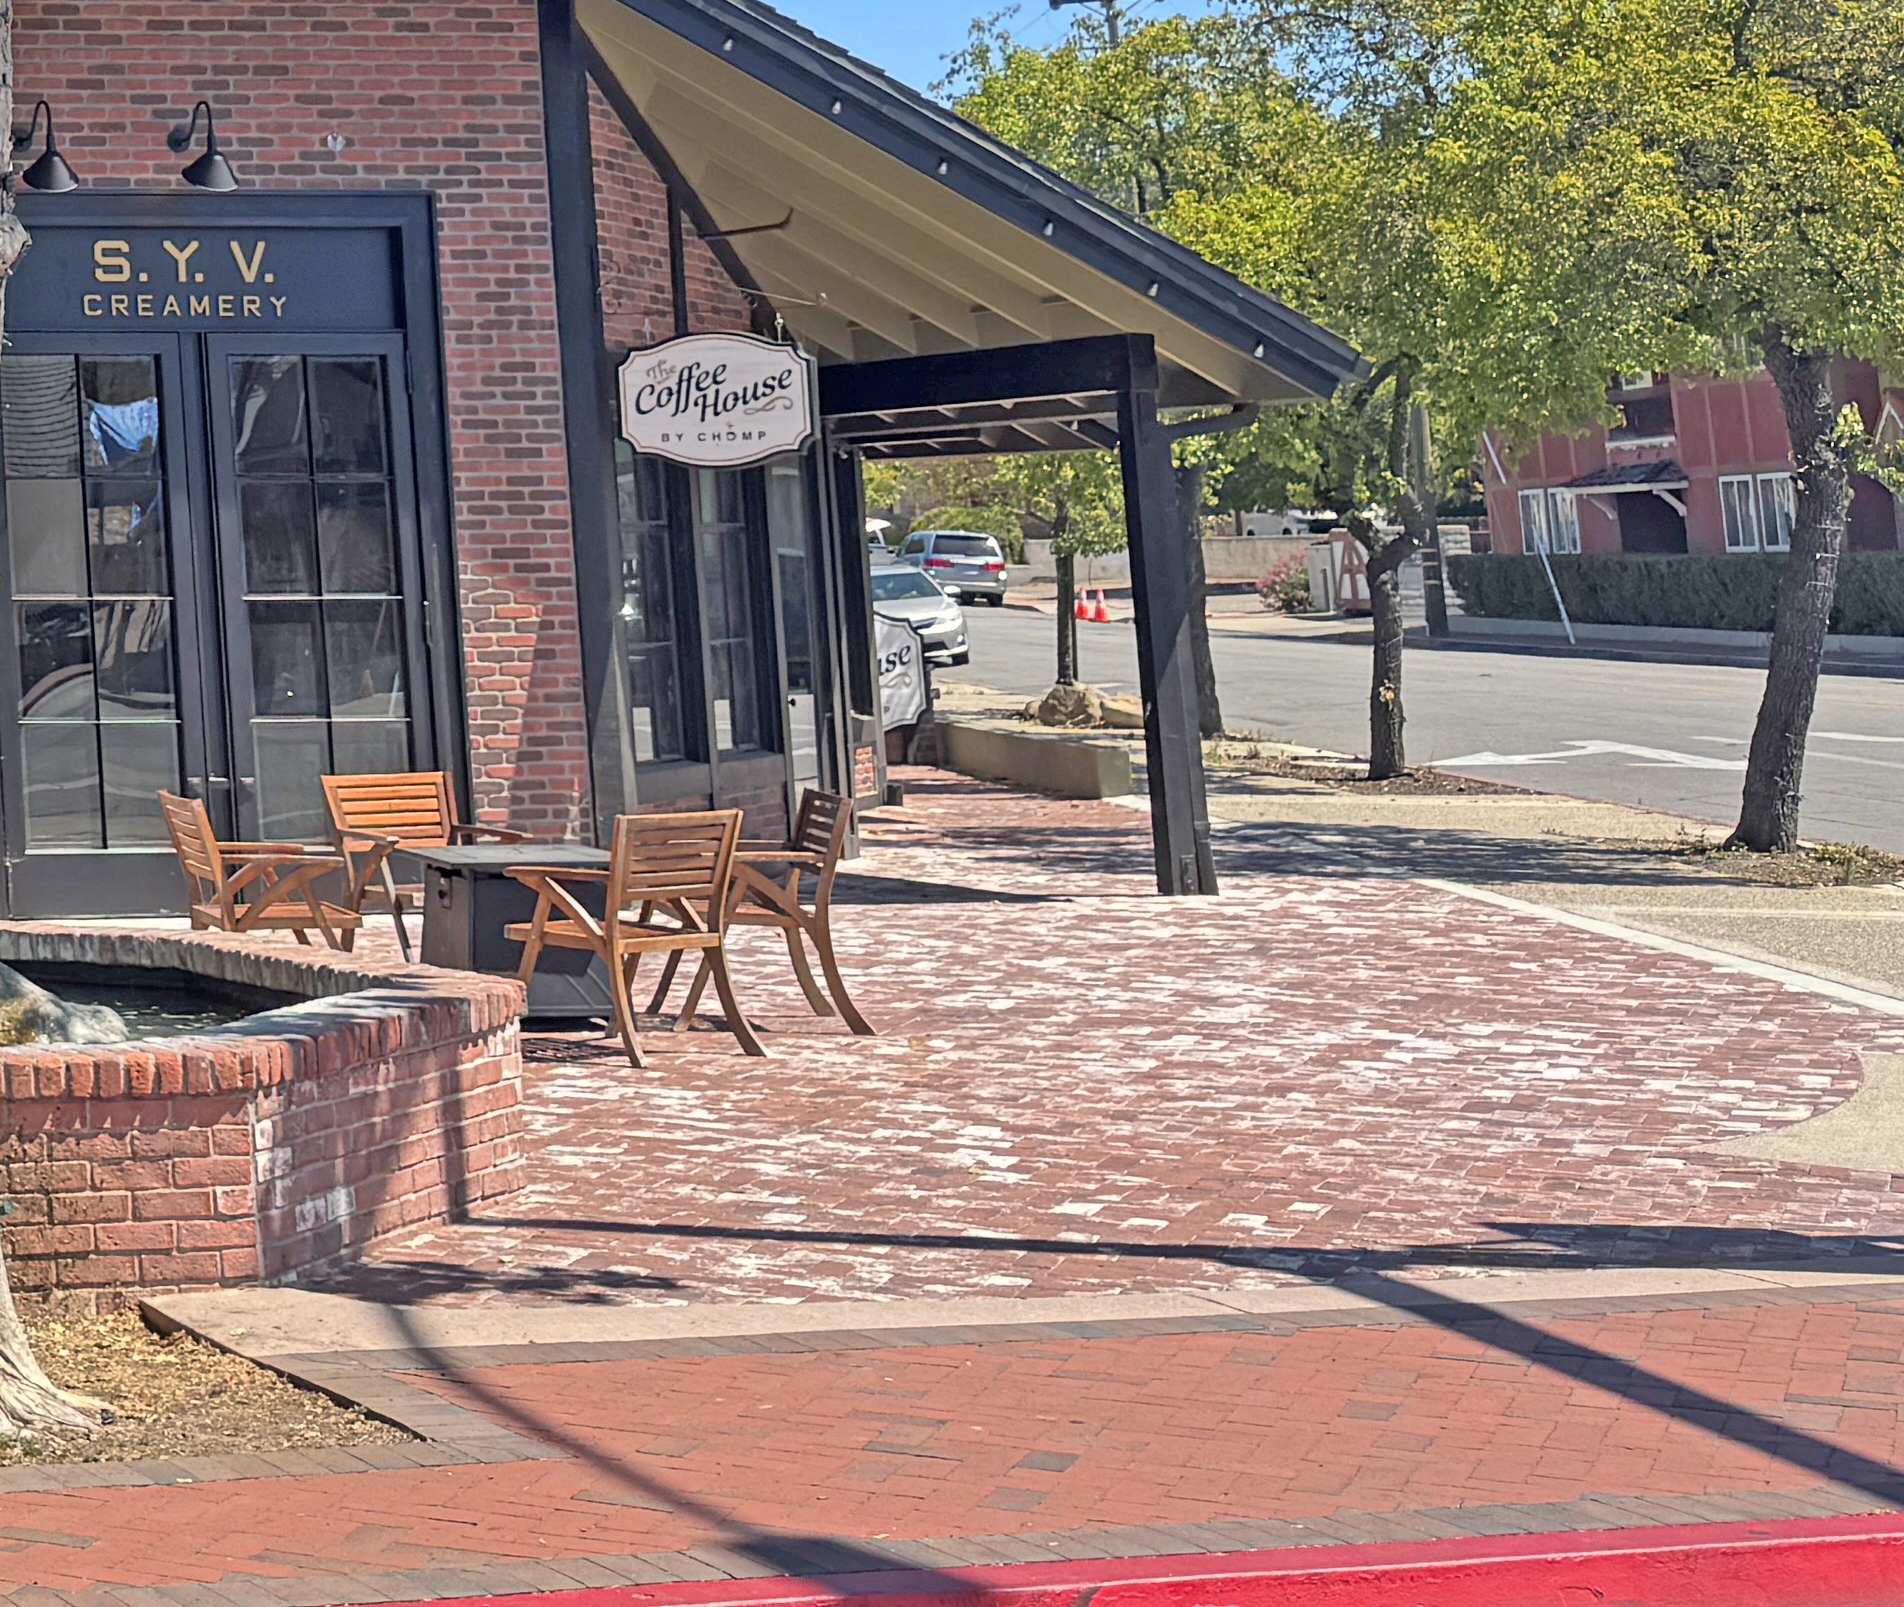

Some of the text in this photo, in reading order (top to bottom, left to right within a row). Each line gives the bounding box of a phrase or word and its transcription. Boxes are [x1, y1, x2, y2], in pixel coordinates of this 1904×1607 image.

[82, 294, 287, 318] CREAMERY
[645, 359, 678, 381] The
[635, 362, 727, 417] Coffee
[694, 368, 793, 422] House
[661, 430, 767, 443] BY CHOMP
